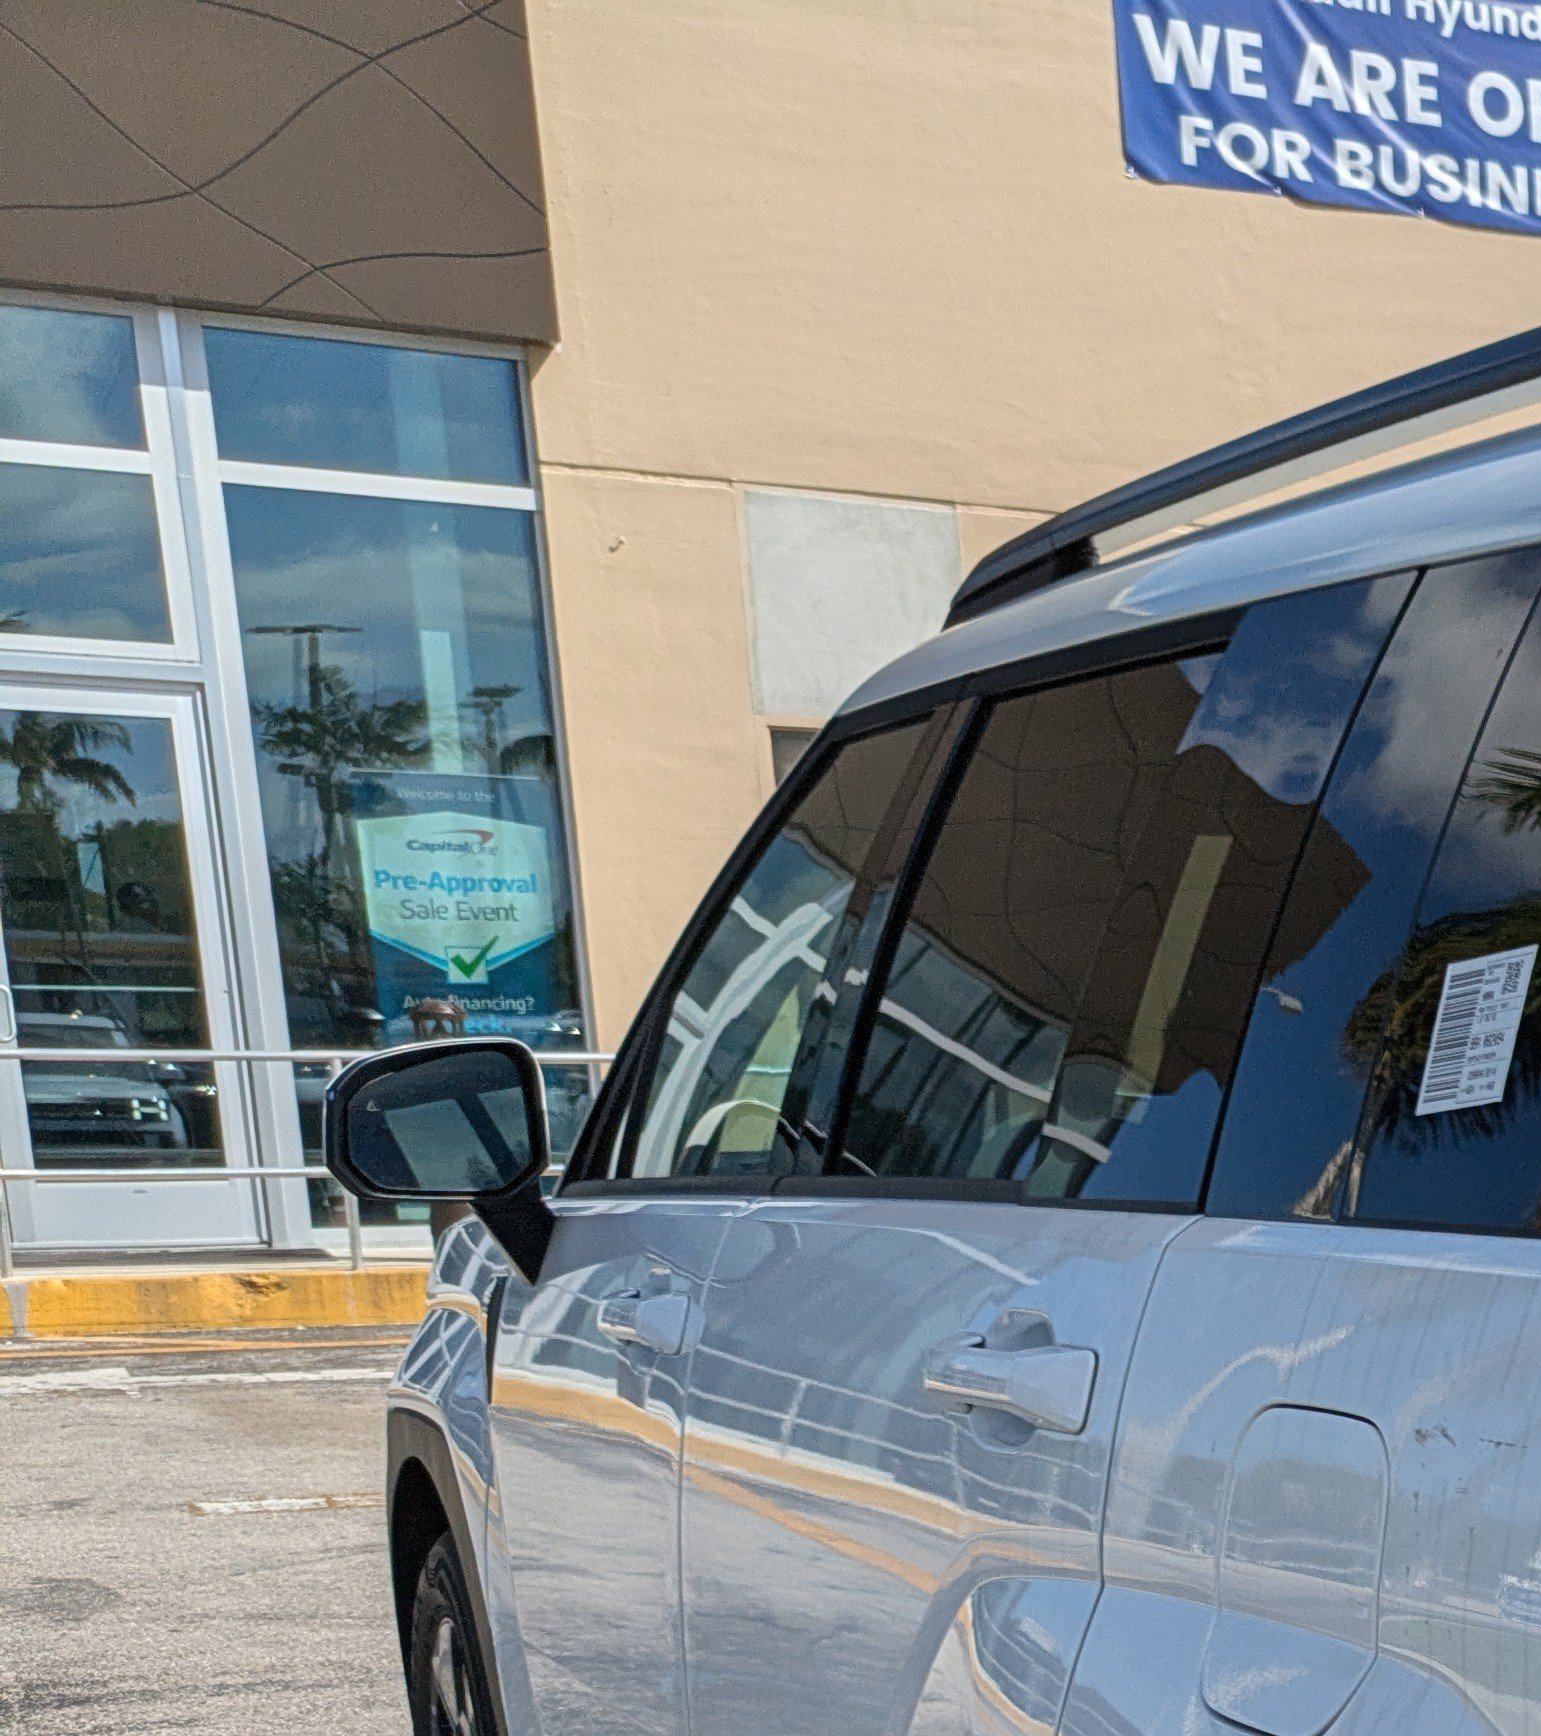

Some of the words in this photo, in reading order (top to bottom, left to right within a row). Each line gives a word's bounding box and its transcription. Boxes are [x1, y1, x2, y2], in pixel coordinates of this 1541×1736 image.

[1132, 14, 1267, 99] WE
[1294, 45, 1443, 128] ARE
[1179, 115, 1313, 183] FOR
[374, 869, 538, 897] Pre-Approval
[400, 898, 448, 921] Sale
[456, 900, 520, 922] Event
